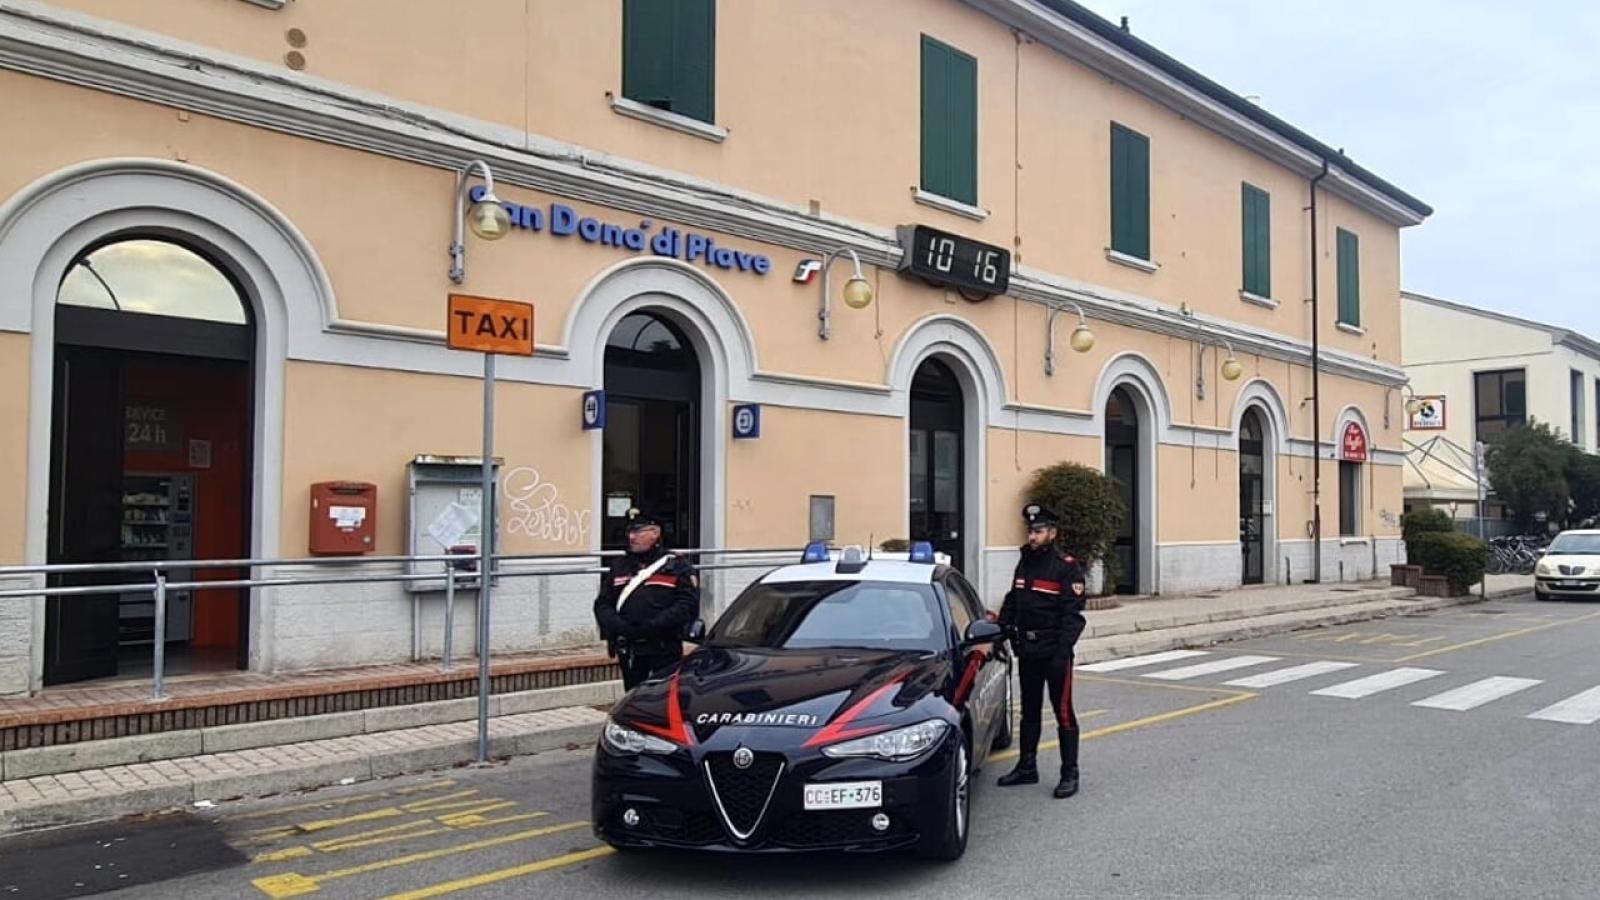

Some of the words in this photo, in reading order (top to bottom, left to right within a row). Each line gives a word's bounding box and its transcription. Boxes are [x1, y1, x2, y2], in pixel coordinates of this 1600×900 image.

[650, 227, 680, 258] di
[686, 233, 771, 275] Piave
[927, 237, 955, 272] 10
[974, 250, 999, 284] 16
[454, 310, 529, 341] TAXI
[128, 423, 152, 443] 24
[696, 712, 819, 726] CARABINIERI
